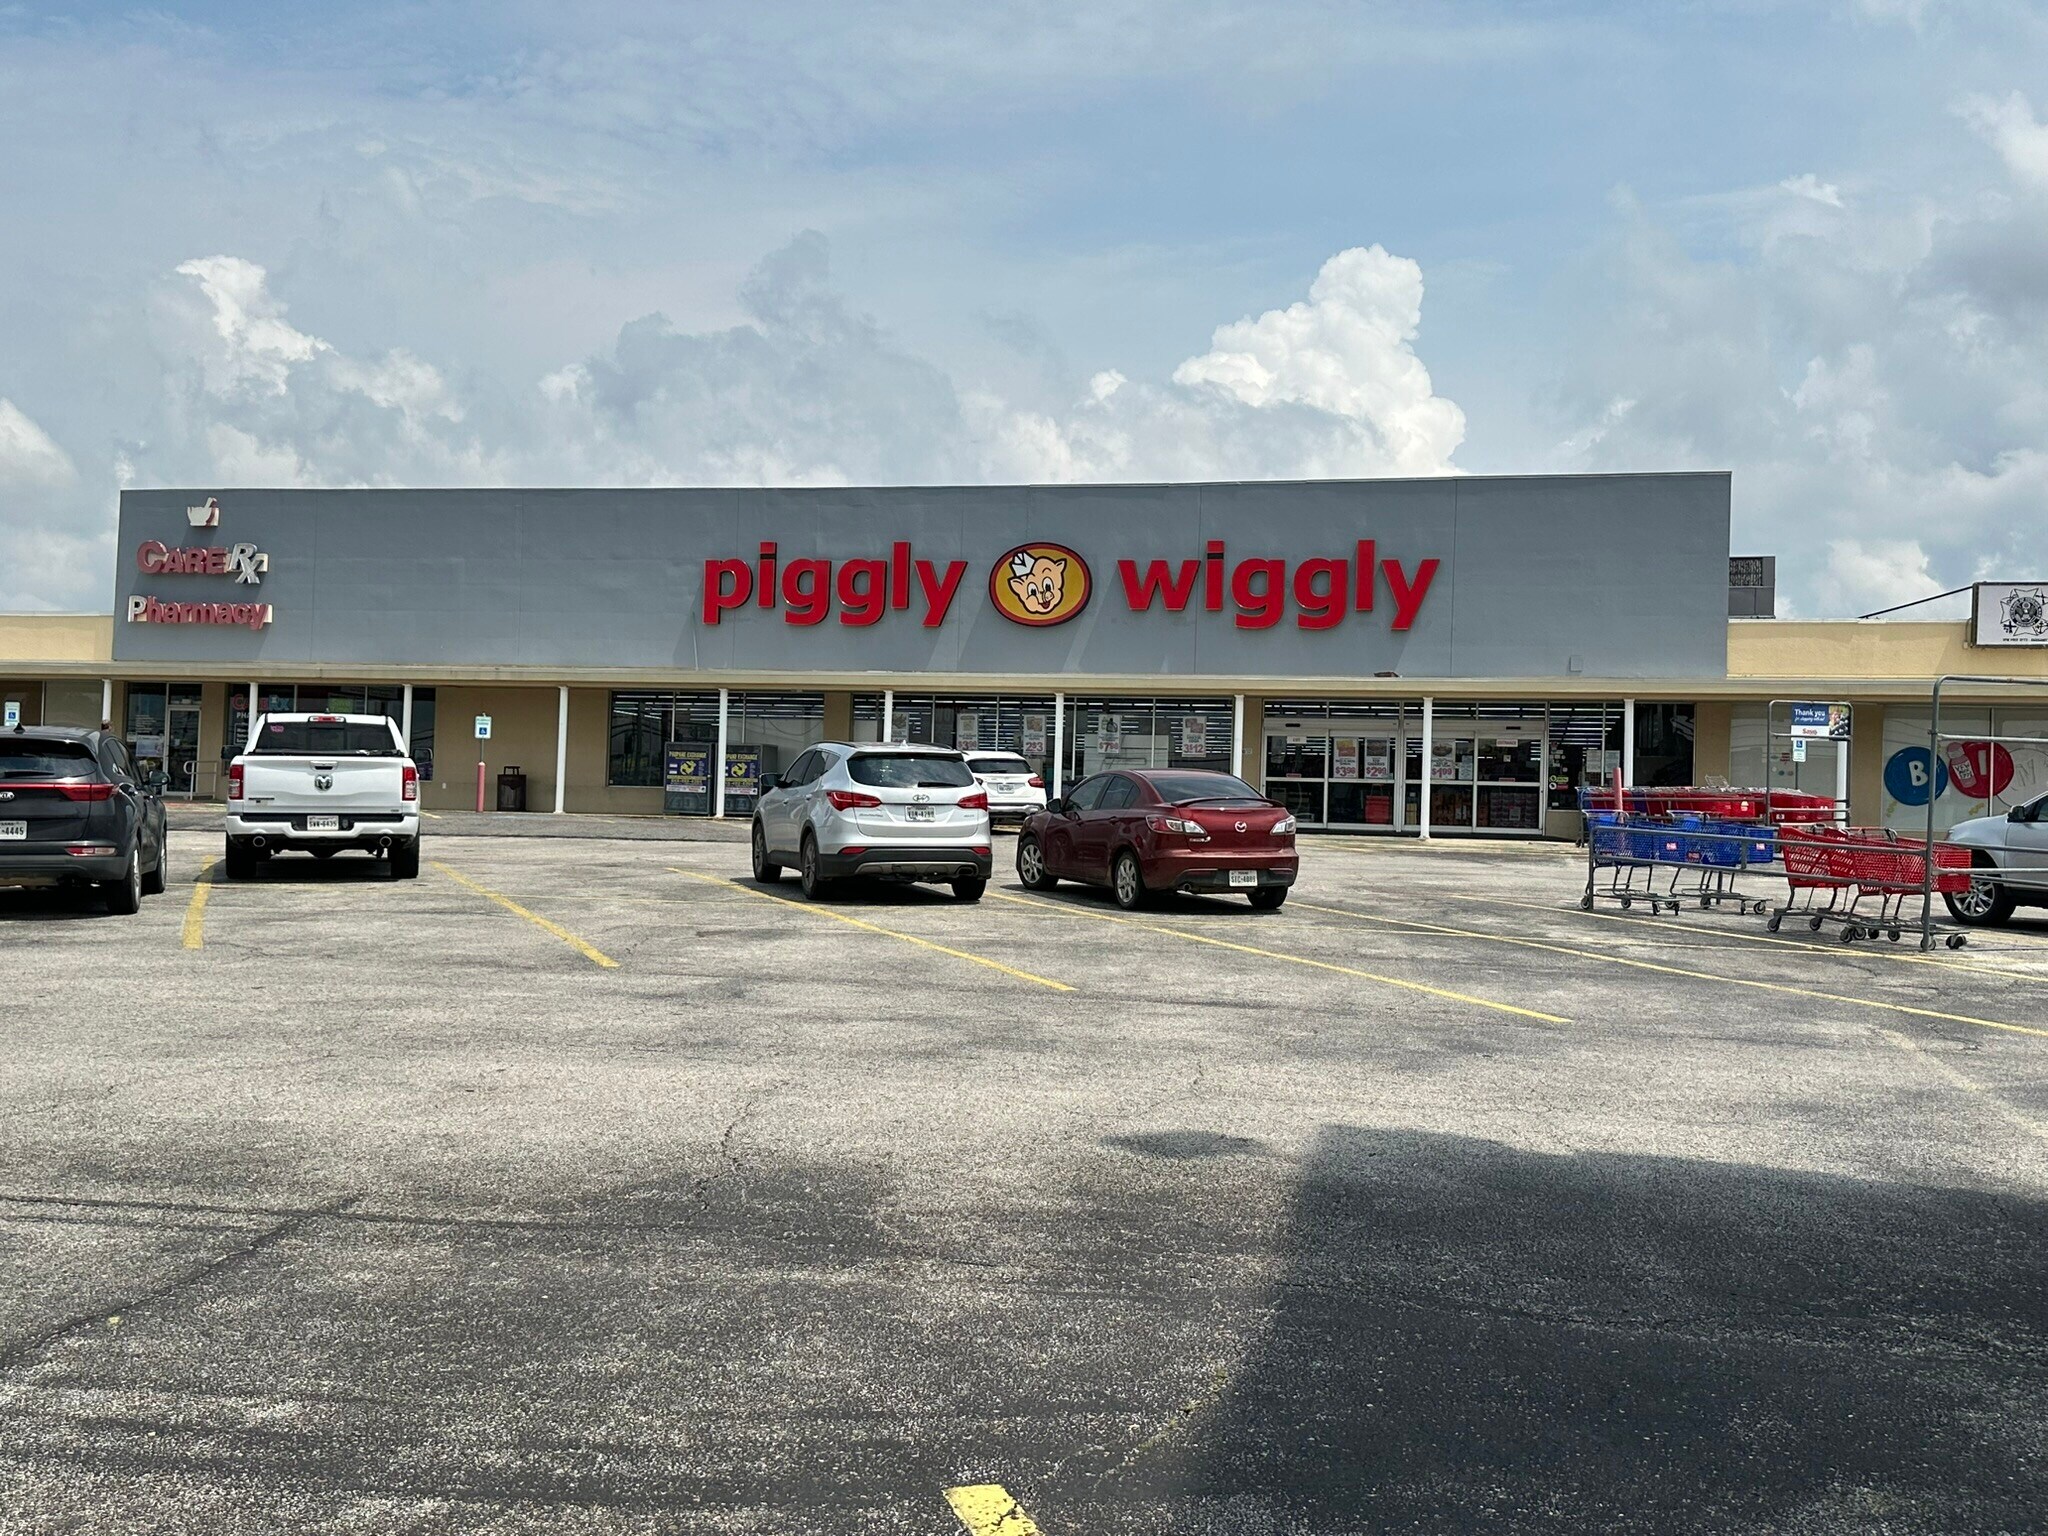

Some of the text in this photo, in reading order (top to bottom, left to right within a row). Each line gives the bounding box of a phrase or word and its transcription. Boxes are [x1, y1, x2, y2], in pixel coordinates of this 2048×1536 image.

[702, 540, 1441, 631] piggly wiggly
[127, 595, 269, 630] Pharmacy
[1814, 710, 1826, 718] you
[1908, 760, 1928, 787] B
[1978, 750, 1987, 776] I
[0, 826, 24, 836] -4445
